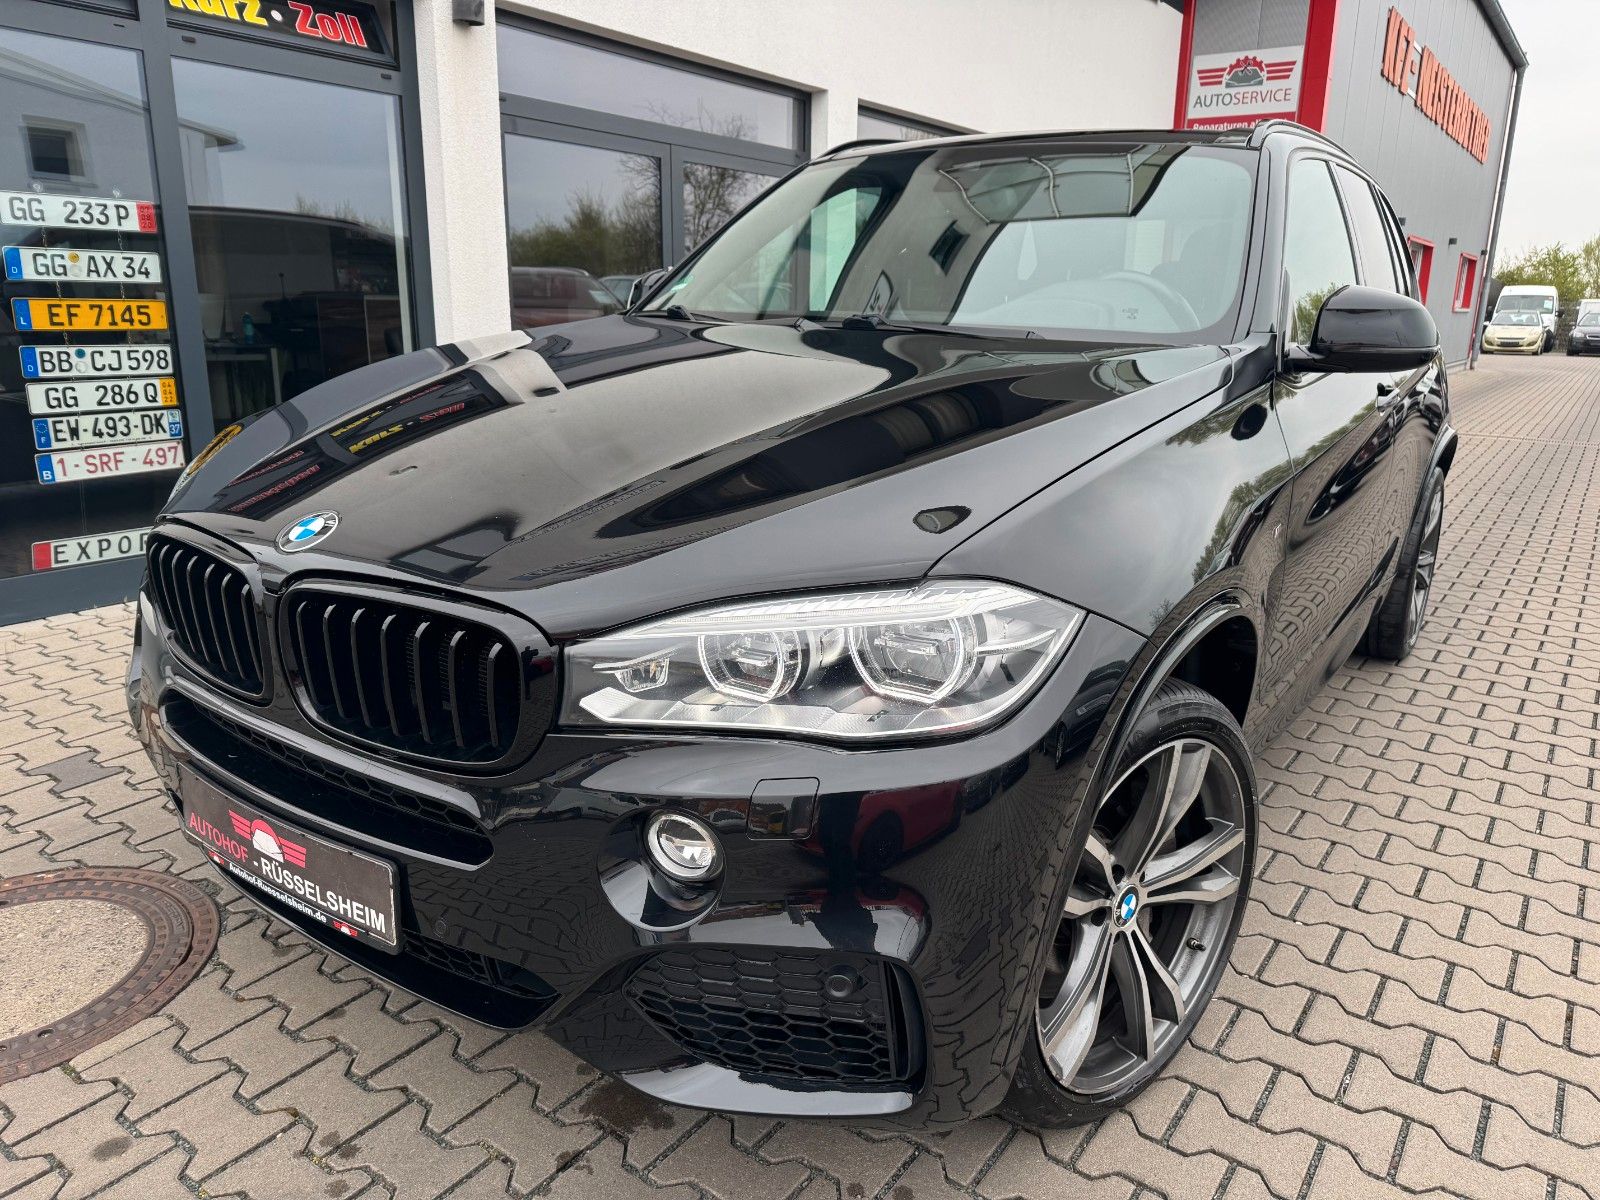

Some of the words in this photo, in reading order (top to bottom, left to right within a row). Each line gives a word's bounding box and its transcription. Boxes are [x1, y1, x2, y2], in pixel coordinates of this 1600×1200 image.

[169, 0, 268, 26] urz
[288, 1, 368, 48] Zoll
[1193, 88, 1292, 108] AUTOSERVICE
[9, 196, 46, 222] GG
[11, 266, 18, 274] D
[32, 252, 68, 276] GG
[20, 316, 27, 325] L
[47, 303, 81, 327] EF
[89, 304, 151, 327] 7145
[27, 364, 34, 372] D
[39, 350, 74, 373] BB
[44, 386, 79, 409] GG
[170, 423, 180, 434] 37
[42, 470, 52, 480] B
[53, 532, 148, 565] EXPOR
[189, 812, 249, 863] AUTOHOF
